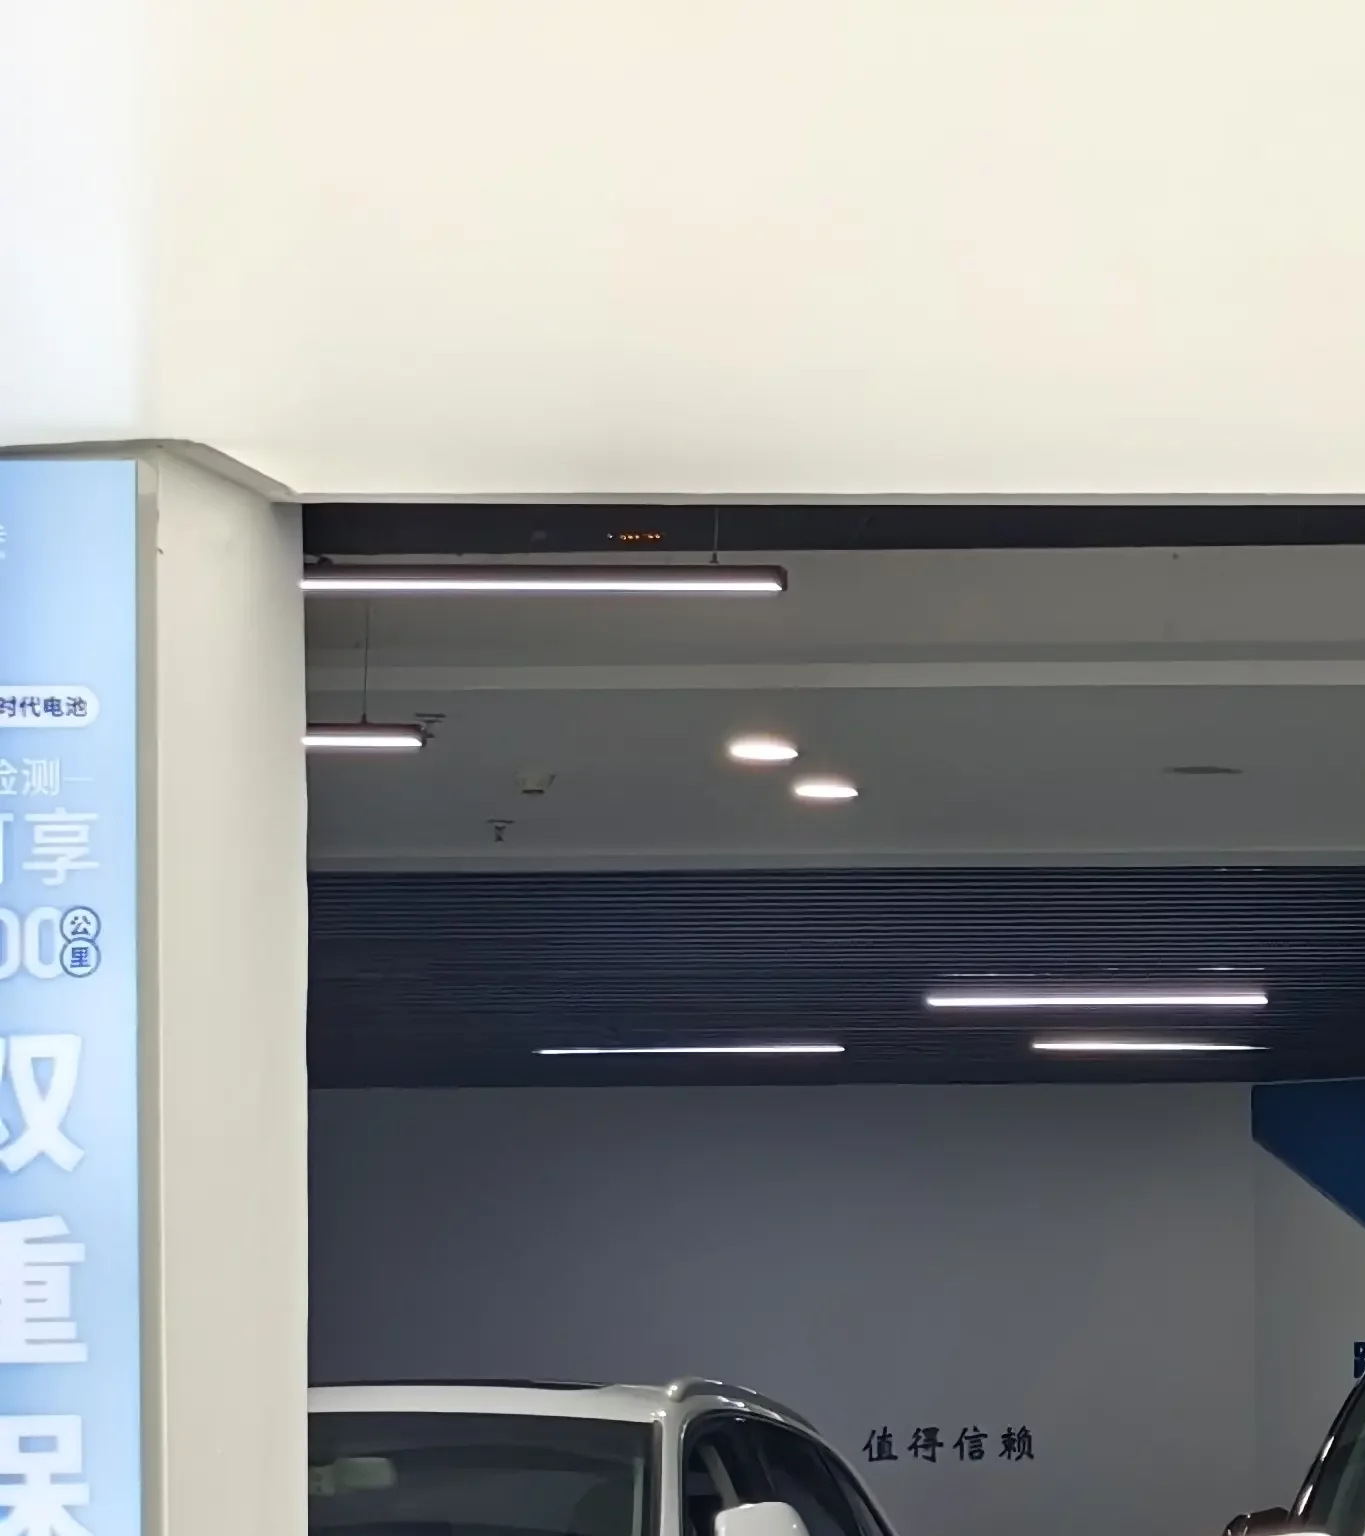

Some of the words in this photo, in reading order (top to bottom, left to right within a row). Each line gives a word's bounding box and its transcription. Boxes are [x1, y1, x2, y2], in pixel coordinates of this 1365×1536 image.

[0, 808, 100, 885] 享
[862, 1425, 1034, 1463] 值得信赖
